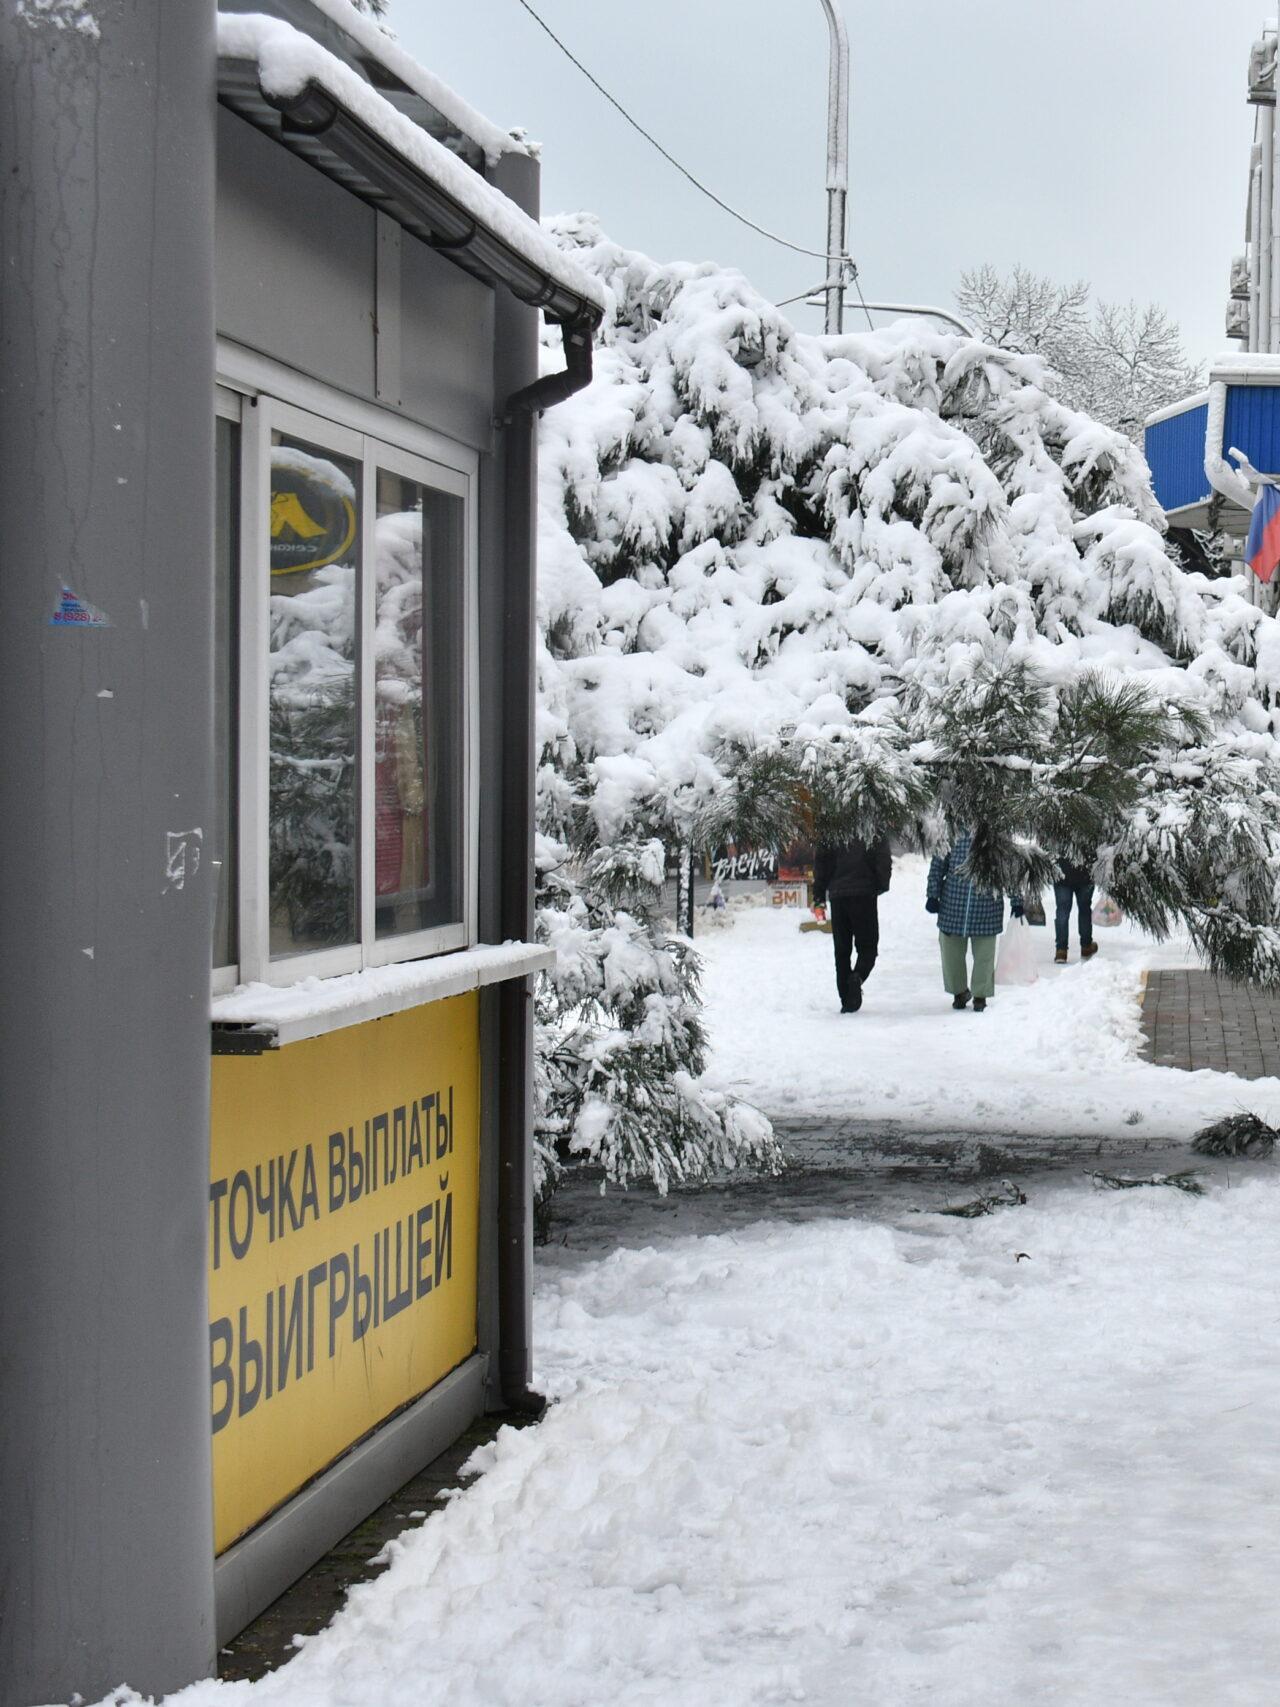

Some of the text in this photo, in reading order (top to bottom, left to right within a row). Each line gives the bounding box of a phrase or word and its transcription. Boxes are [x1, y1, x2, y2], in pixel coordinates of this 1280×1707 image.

[209, 1086, 453, 1271] ТОЧКА ВЫПЛАТЫ
[209, 1170, 453, 1436] ВЫИГРЫШЕЙ
